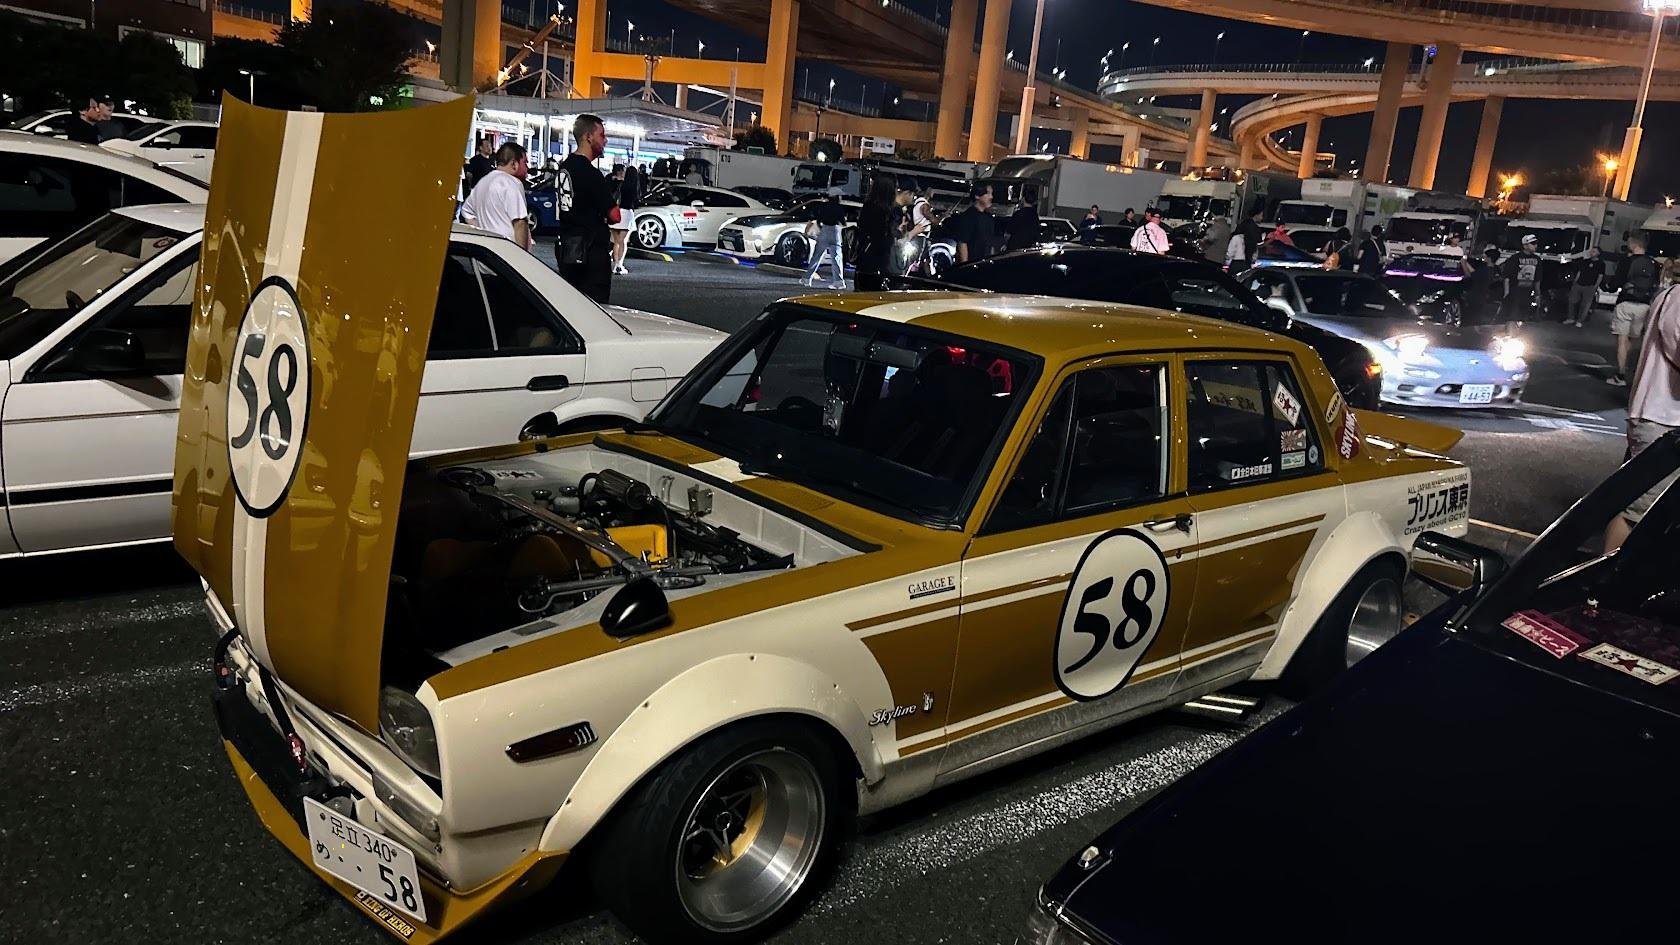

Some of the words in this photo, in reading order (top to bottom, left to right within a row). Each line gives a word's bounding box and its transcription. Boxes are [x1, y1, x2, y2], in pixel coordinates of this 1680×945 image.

[231, 333, 297, 460] 58
[1407, 483, 1469, 526] プリンス東京
[1404, 524, 1425, 536] Crazy
[1427, 518, 1447, 528] about
[908, 577, 946, 594] GARAGE
[948, 575, 955, 586] E
[1064, 569, 1155, 674] 58
[868, 704, 917, 726] Skyline
[316, 840, 330, 859] め
[331, 816, 361, 848] 足立
[363, 833, 391, 862] 340
[378, 905, 392, 920] OF
[386, 914, 415, 936] HEROS
